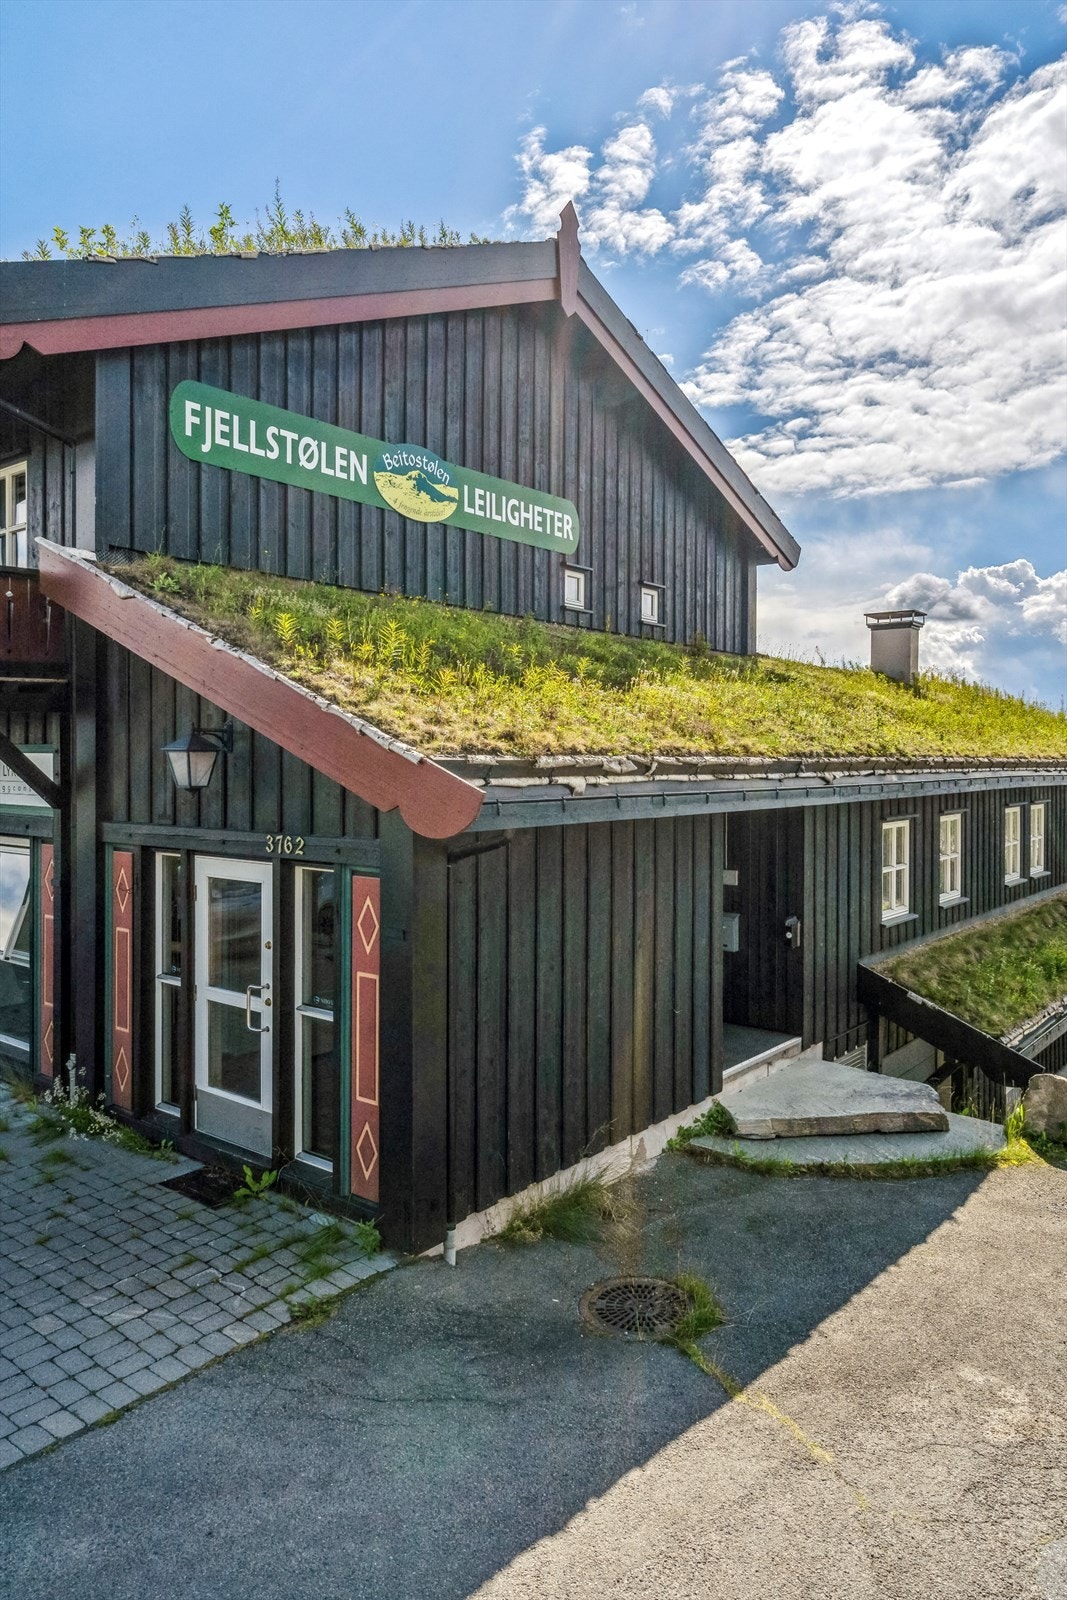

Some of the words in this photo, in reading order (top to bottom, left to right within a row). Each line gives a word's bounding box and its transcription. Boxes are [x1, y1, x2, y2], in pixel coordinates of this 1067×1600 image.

[184, 400, 368, 485] FJELLSTØLEN
[382, 450, 450, 485] Beitostølen
[463, 484, 574, 541] LEILIGHETER
[265, 834, 305, 855] 3762
